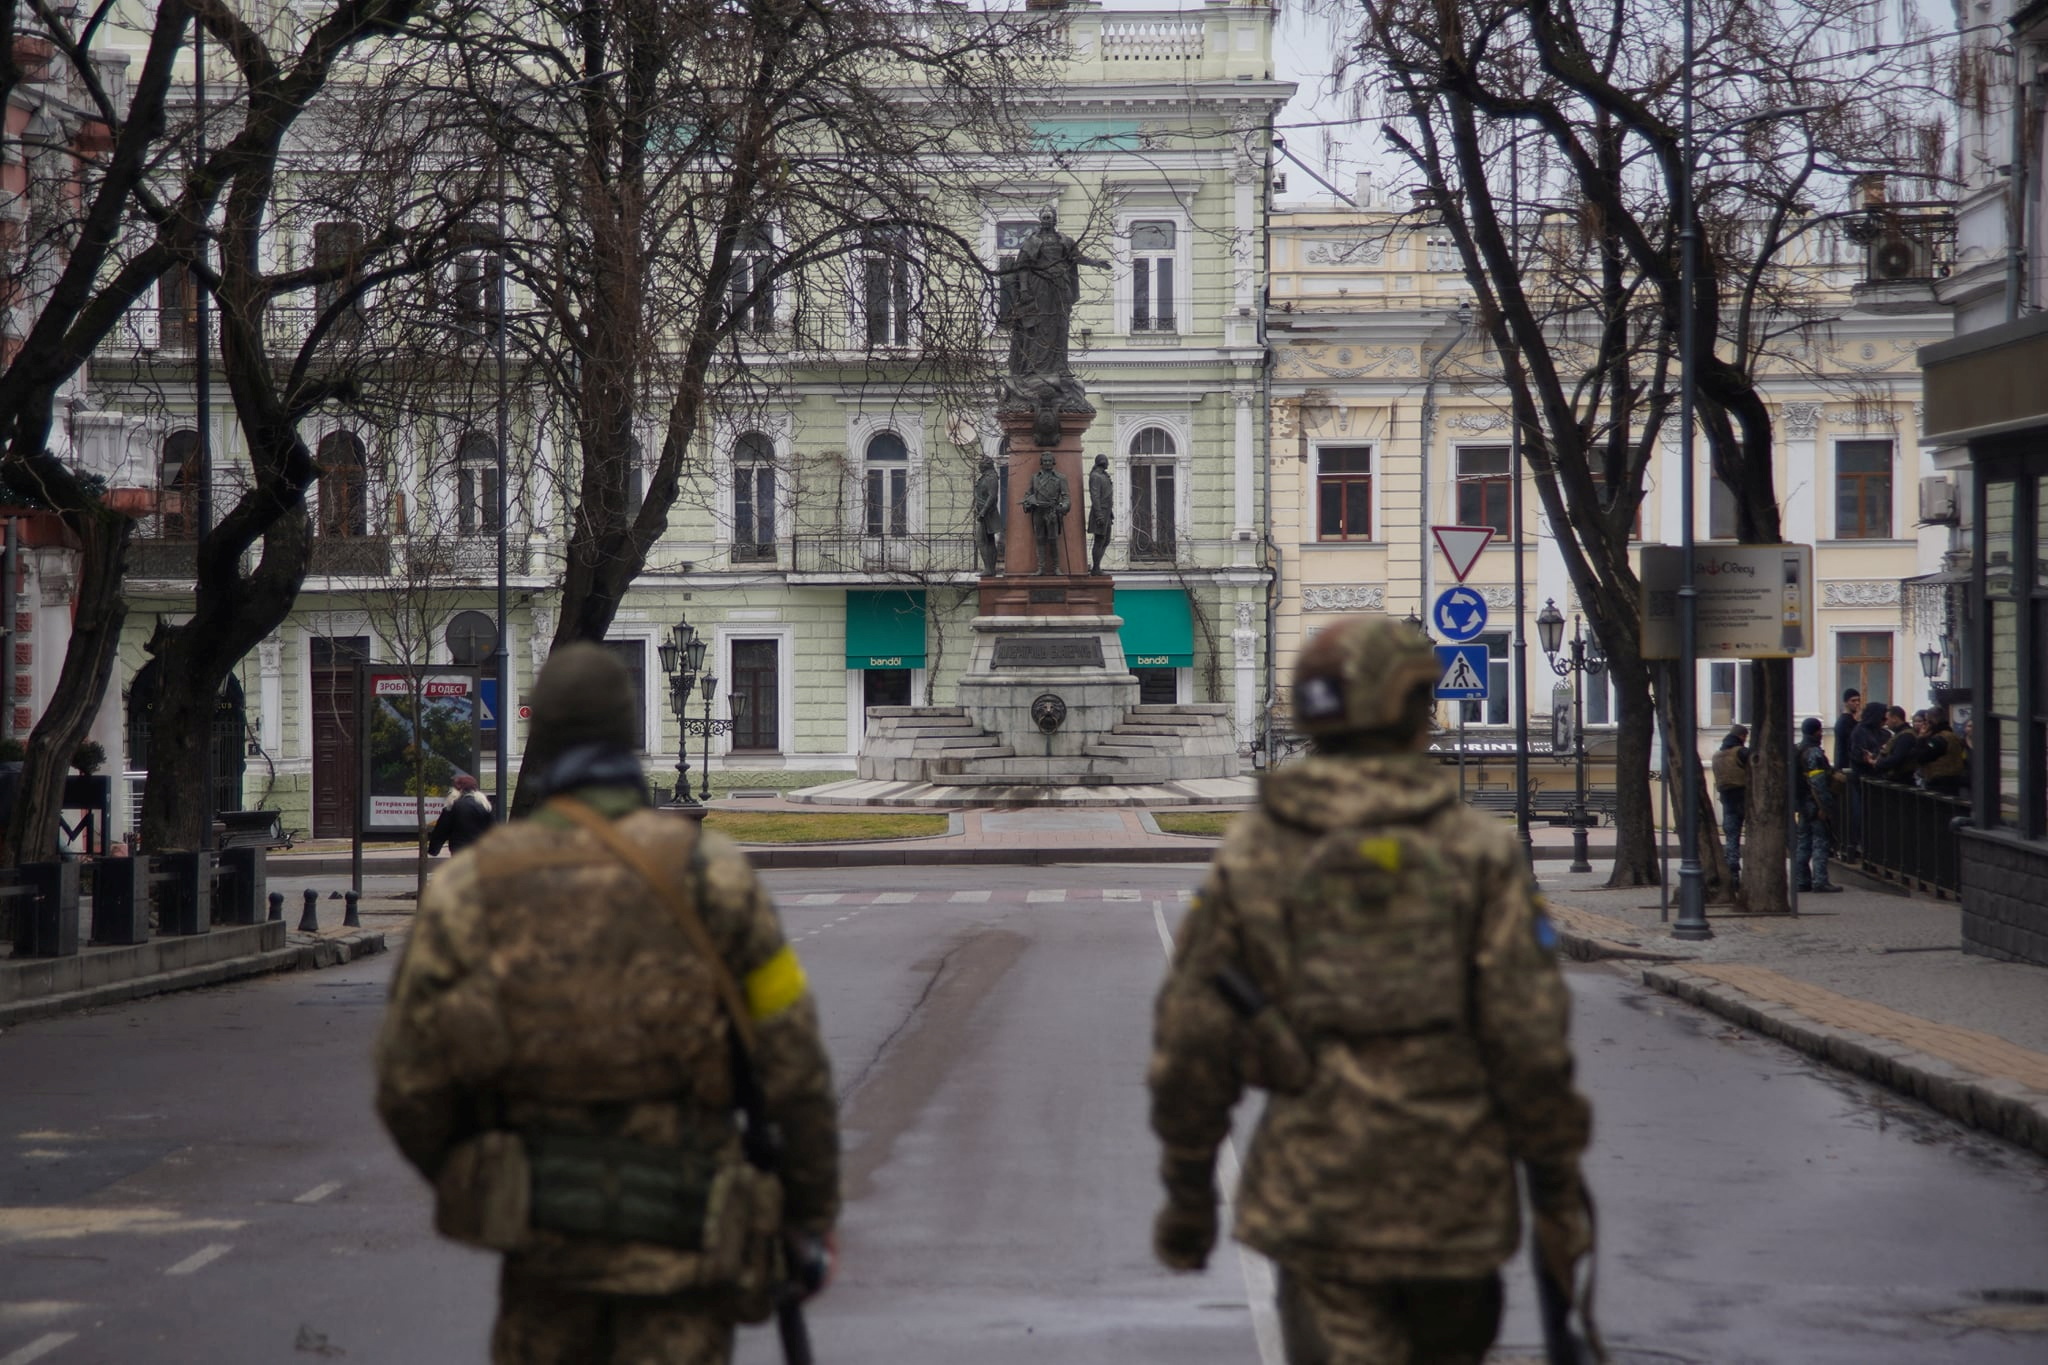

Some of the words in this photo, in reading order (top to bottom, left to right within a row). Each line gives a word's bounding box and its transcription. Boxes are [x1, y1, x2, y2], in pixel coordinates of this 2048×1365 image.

[379, 682, 423, 691] ЗРОБЛ
[430, 685, 437, 693] В
[438, 686, 463, 694] ОДЕСІ
